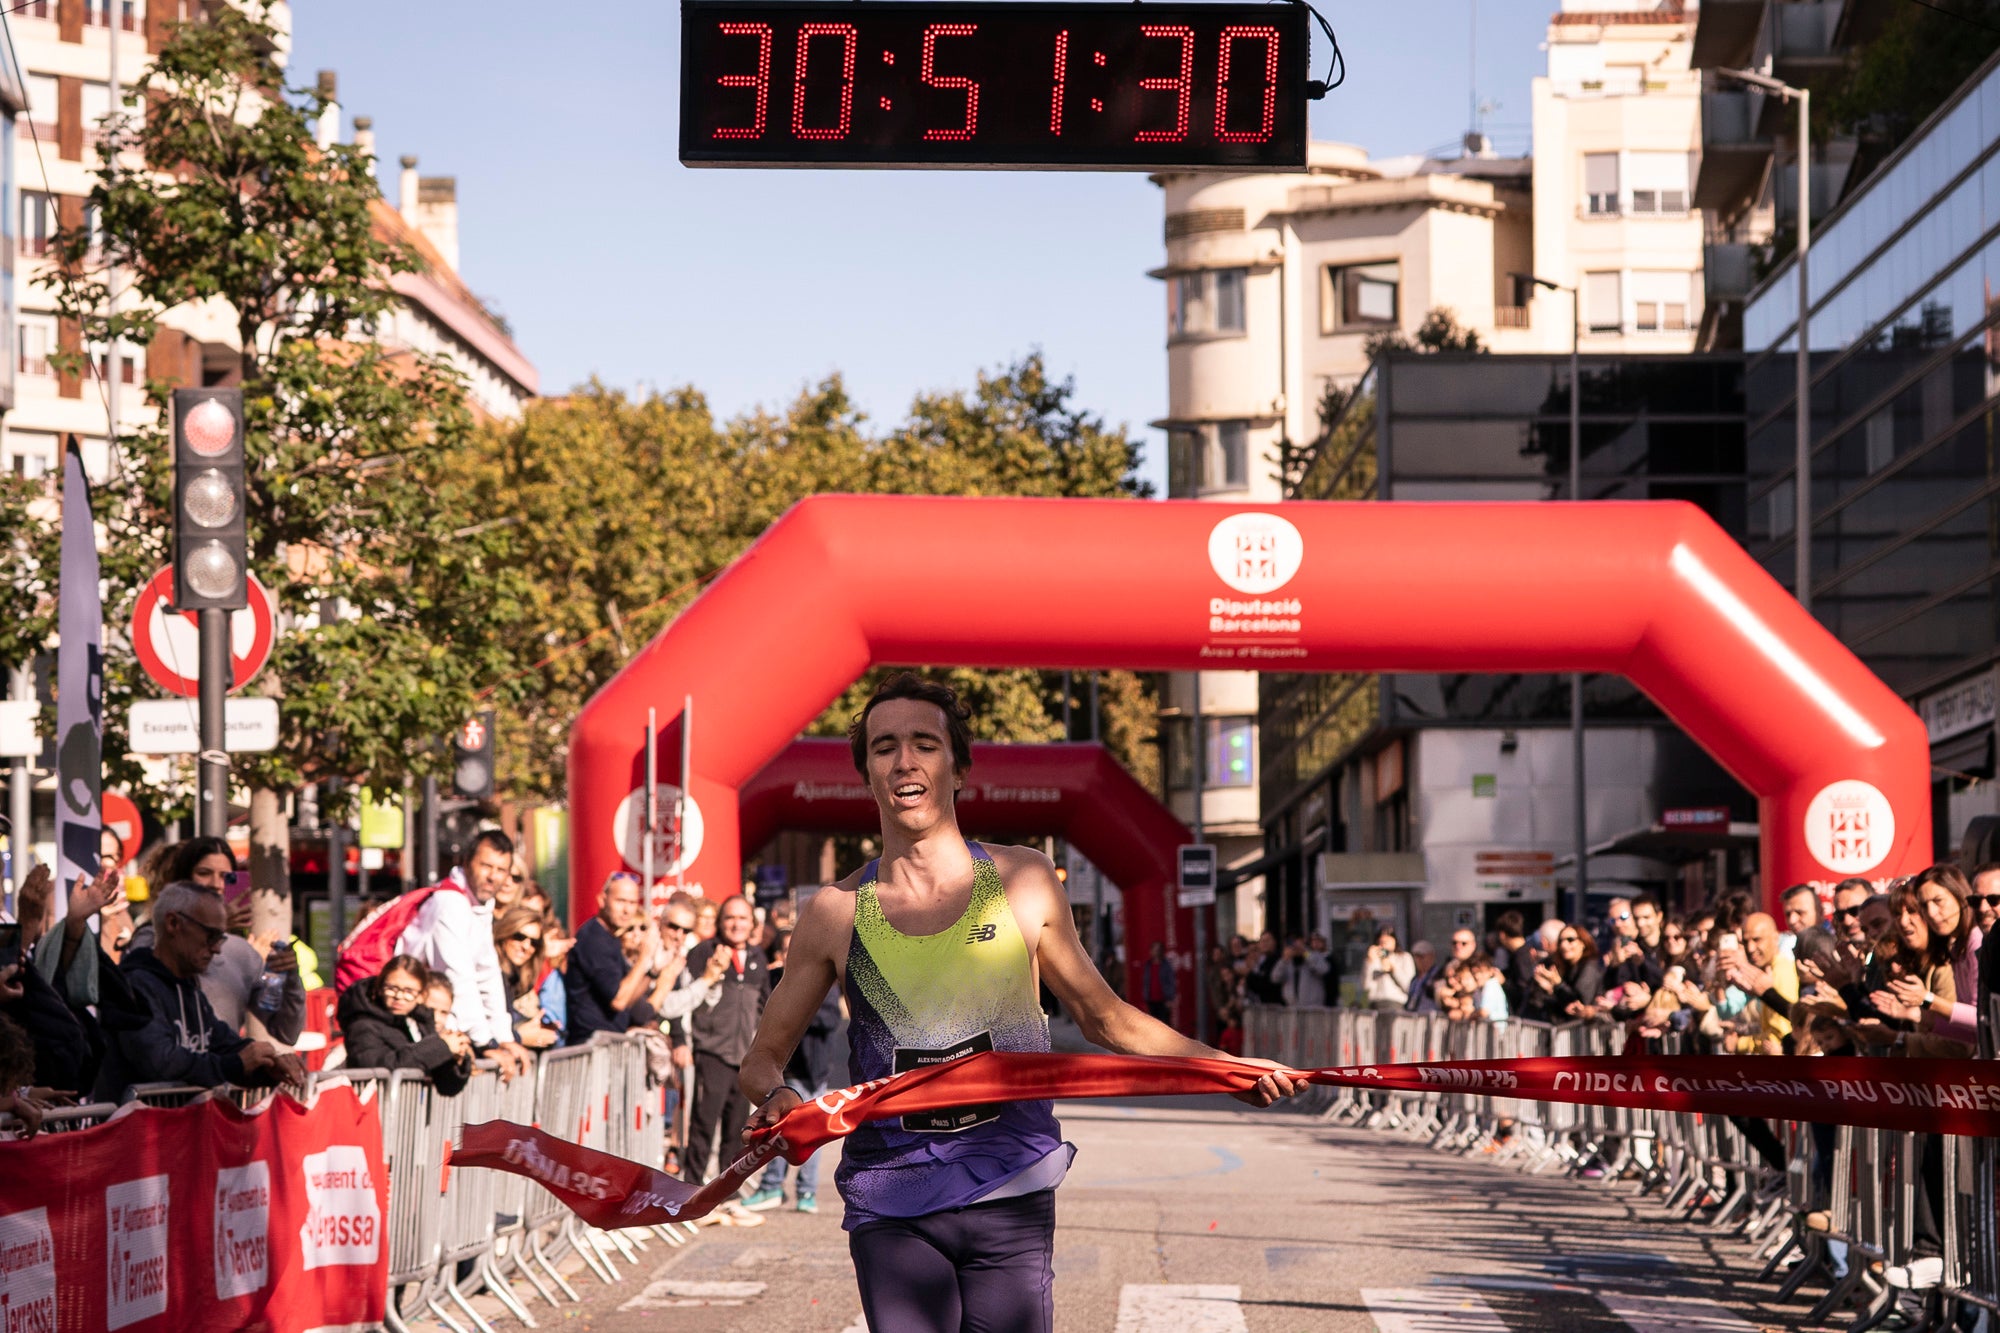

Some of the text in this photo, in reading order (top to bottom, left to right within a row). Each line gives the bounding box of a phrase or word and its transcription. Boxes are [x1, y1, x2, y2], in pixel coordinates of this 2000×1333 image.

[712, 22, 1282, 143] 30:51:30
[1210, 598, 1302, 617] Diputació
[1209, 616, 1301, 632] Barcelona
[225, 720, 263, 731] octurn
[982, 783, 1061, 802] Terrassa
[1818, 1080, 1878, 1103] PAU
[124, 1250, 164, 1303] Terrassa
